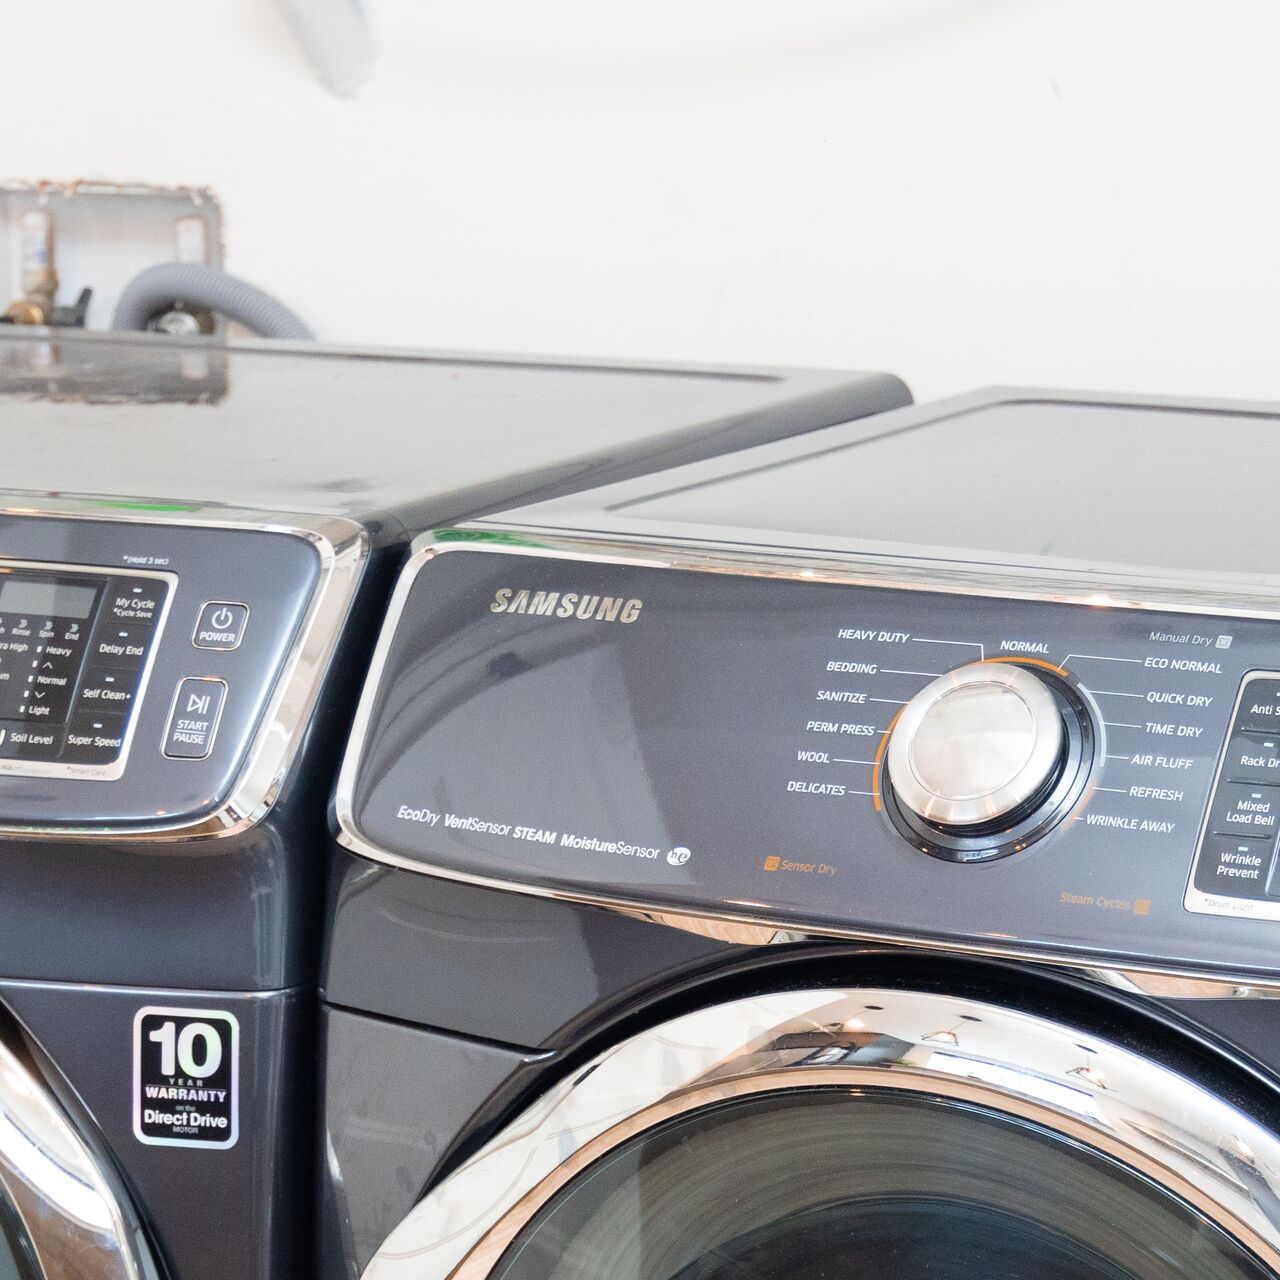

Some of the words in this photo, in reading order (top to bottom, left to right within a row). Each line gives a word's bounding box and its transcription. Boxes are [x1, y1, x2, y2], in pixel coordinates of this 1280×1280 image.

[116, 597, 130, 608] My
[132, 598, 155, 609] Cycle
[490, 588, 643, 624] SAMSUNG
[200, 632, 235, 642] POWER
[838, 629, 877, 640] HEAVY
[878, 631, 910, 643] DUTY
[1149, 632, 1189, 643] Manual
[1192, 636, 1213, 647] Dry
[10, 642, 28, 652] High
[46, 646, 72, 657] Heavy
[99, 644, 124, 656] Delay
[126, 646, 144, 656] End
[1000, 640, 1050, 653] NORMAL
[826, 662, 877, 674] BEDDING
[1144, 657, 1168, 668] ECO
[1170, 660, 1222, 674] NORMAL
[37, 676, 67, 686] Normal
[83, 689, 101, 698] Self
[816, 690, 866, 704] SANITIZE
[1147, 691, 1185, 704] QUICK
[1186, 696, 1213, 707] DRY
[29, 706, 50, 715] Light
[1250, 704, 1273, 715] Anti
[177, 720, 209, 731] START
[806, 721, 838, 733] PERM
[840, 724, 875, 735] PRESS
[1145, 723, 1174, 735] TIME
[1175, 725, 1204, 738] DRY
[10, 733, 27, 742] Soil
[29, 734, 54, 745] Level
[68, 735, 93, 746] Super
[94, 737, 121, 747] Speed
[173, 732, 205, 744] PAUSE
[797, 751, 830, 763] WOOL
[1131, 754, 1153, 766] AIR
[1155, 757, 1194, 769] FLUFF
[1240, 756, 1266, 767] Rack
[787, 781, 846, 795] DELICATES
[1129, 786, 1184, 801] REFRESH
[1237, 801, 1270, 813] Mixed
[1086, 814, 1137, 830] WRINKLE
[1139, 818, 1175, 833] AWAY
[1226, 812, 1252, 823] Load
[1254, 814, 1275, 825] Bell
[396, 805, 440, 826] EcoDry
[443, 814, 512, 836] VentSensor
[513, 826, 557, 845] STEAM
[560, 834, 660, 859] MoistureSensor
[1221, 853, 1262, 866] Wrinkle
[780, 860, 815, 873] Sensor
[818, 863, 838, 876] Dry
[1217, 866, 1259, 880] Prevent
[1060, 891, 1094, 906] Steam
[1096, 895, 1131, 911] Cycles
[149, 1022, 223, 1078] 10
[169, 1078, 203, 1087] YEAR
[146, 1087, 226, 1102] WARRANTY
[144, 1109, 188, 1125] Direct
[190, 1113, 228, 1128] Drive
[173, 1126, 198, 1134] MOTOR
